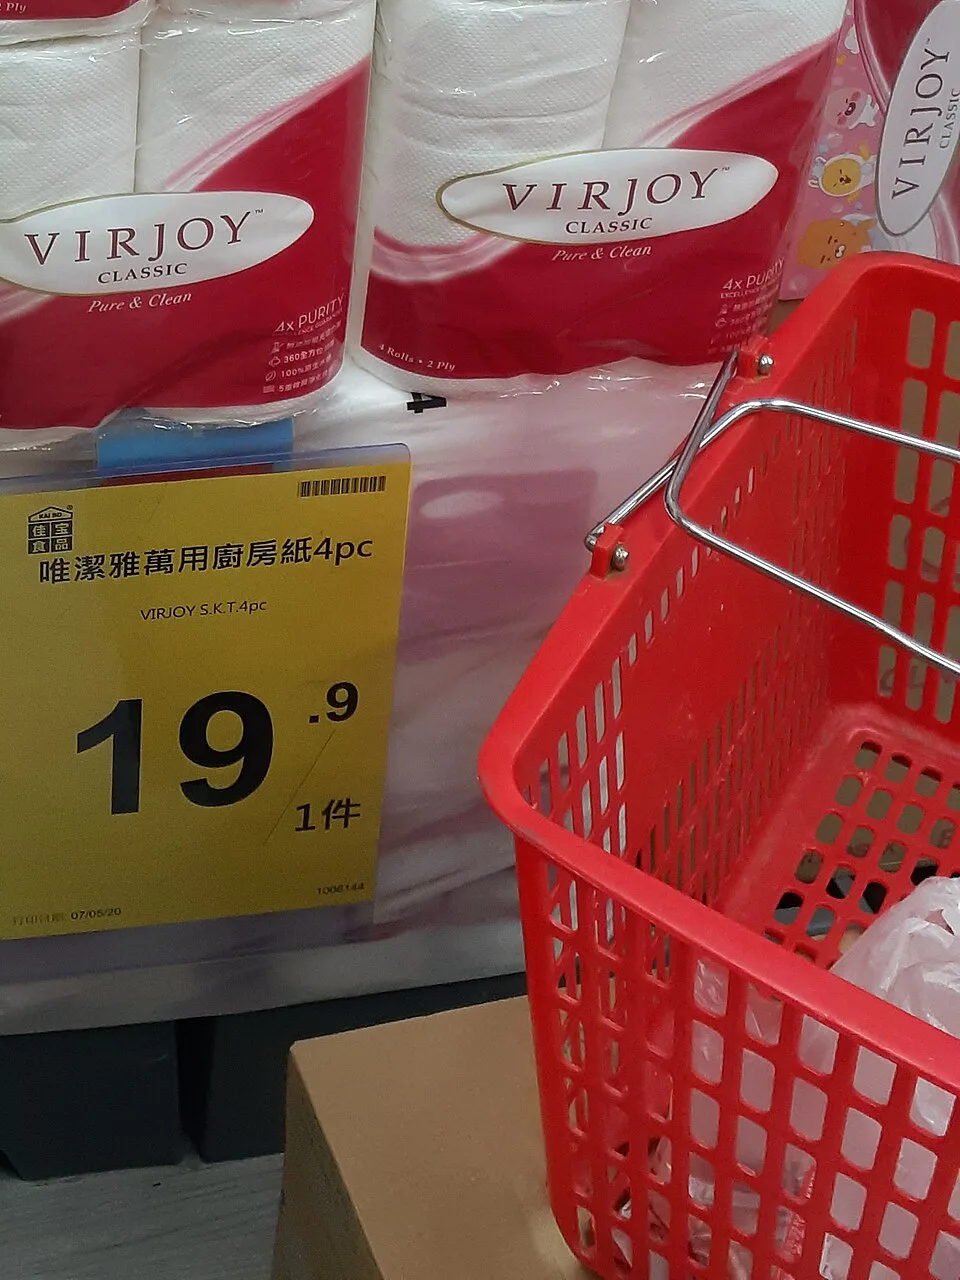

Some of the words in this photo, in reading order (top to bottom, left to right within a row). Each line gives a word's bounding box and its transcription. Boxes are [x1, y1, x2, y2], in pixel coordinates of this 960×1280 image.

[5, 1, 27, 14] Ply
[891, 48, 950, 200] VIRJOY
[502, 167, 719, 217] VIRJOY
[24, 209, 252, 265] VIRJOY
[565, 218, 652, 235] CLASSIC
[551, 248, 586, 261] Pure
[591, 247, 604, 260] &
[609, 244, 651, 258] Clean
[98, 262, 188, 284] CLASSIC
[87, 298, 126, 314] Pure
[129, 295, 142, 309] &
[148, 292, 192, 307] Clean
[298, 292, 344, 328] PURITY
[387, 347, 414, 363] Rolls
[427, 360, 433, 368] 2
[437, 361, 455, 372] Ply
[40, 536, 373, 585] 唯潔雅萬用廚房紙4pc
[140, 606, 196, 620] VIRJOY
[199, 599, 268, 617] S.K.T.4pc
[76, 690, 275, 816] 19
[309, 681, 360, 725] .9
[294, 798, 362, 833] 1件
